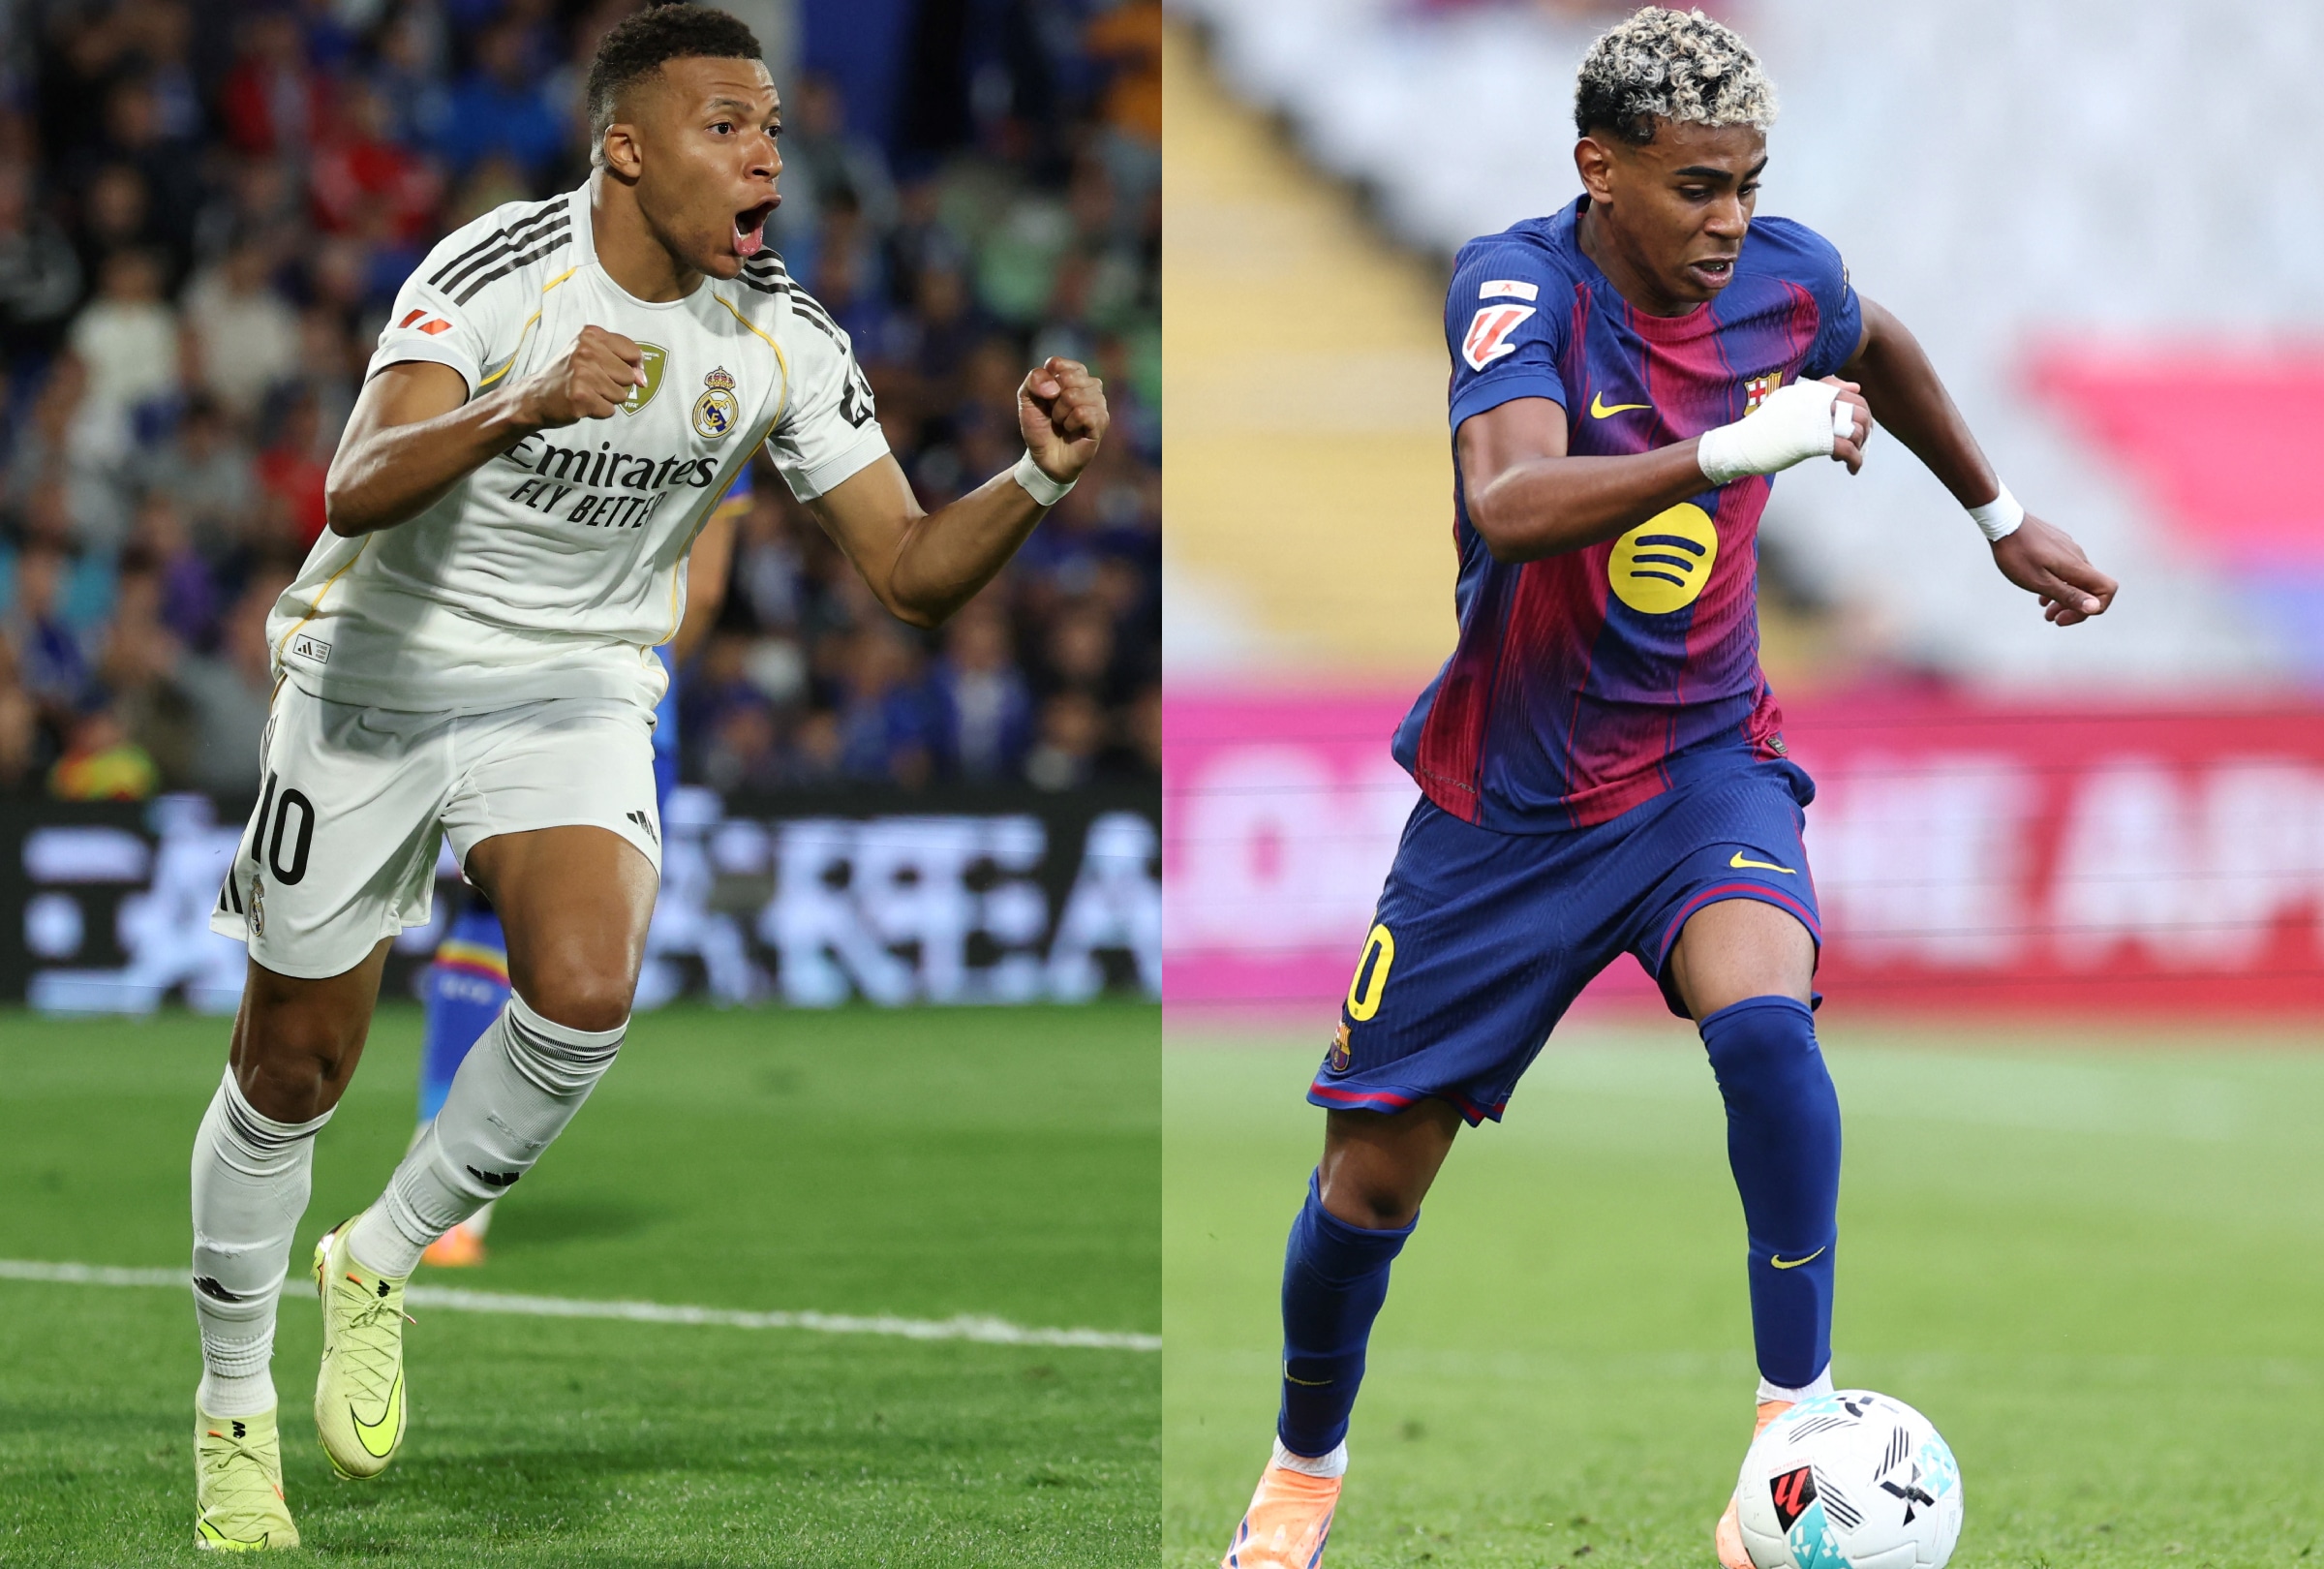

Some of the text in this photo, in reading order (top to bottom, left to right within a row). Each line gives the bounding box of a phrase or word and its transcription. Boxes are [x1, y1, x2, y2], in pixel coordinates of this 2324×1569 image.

[504, 432, 719, 491] Emirates
[509, 478, 667, 529] FLY BETTER
[252, 768, 315, 885] 10
